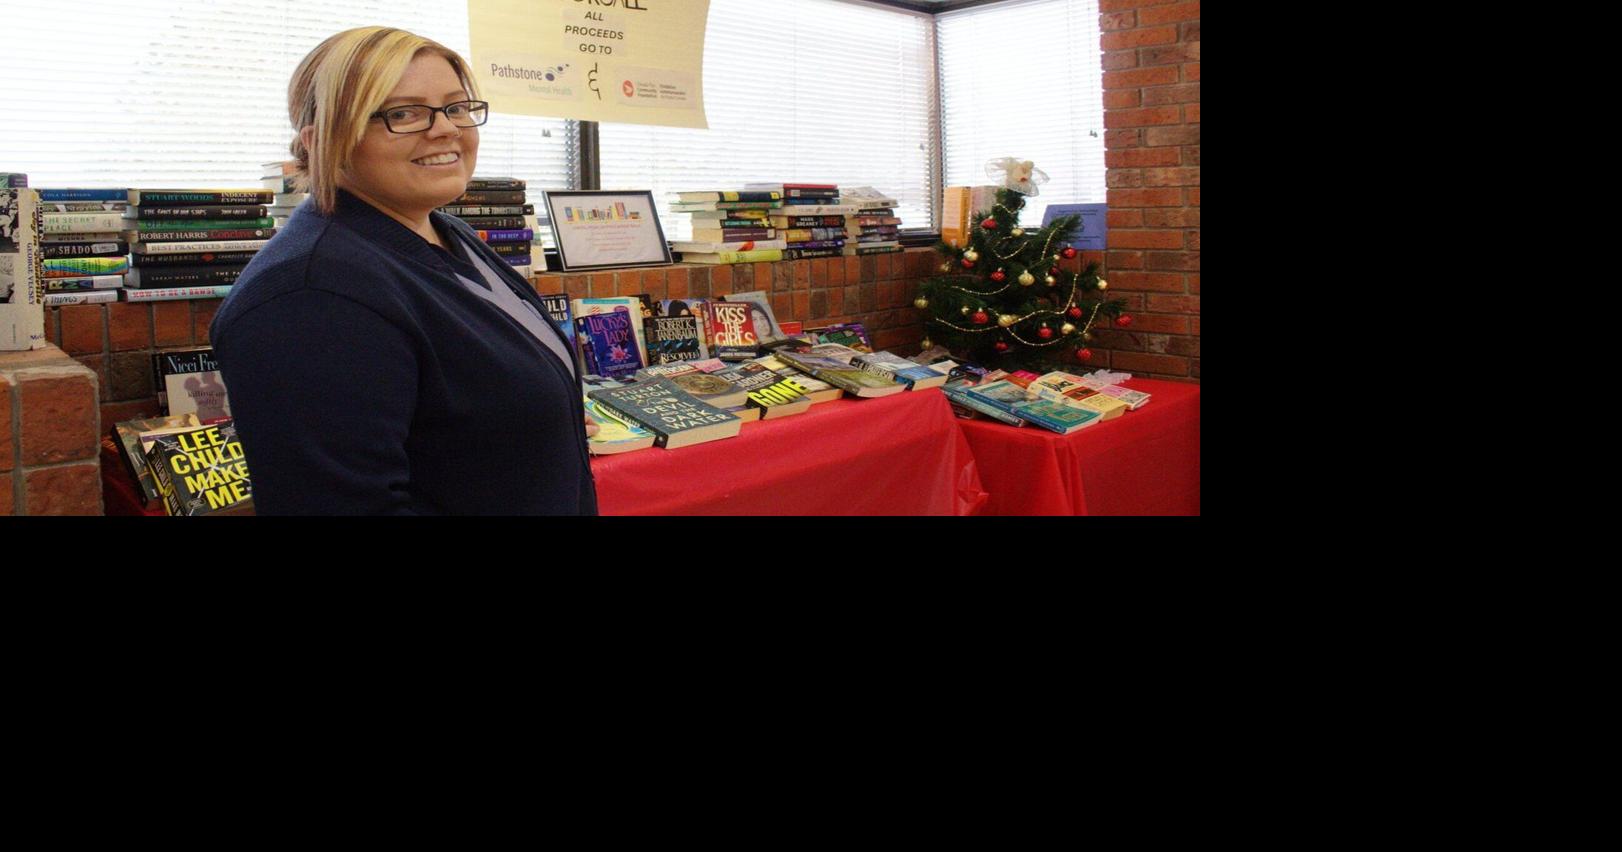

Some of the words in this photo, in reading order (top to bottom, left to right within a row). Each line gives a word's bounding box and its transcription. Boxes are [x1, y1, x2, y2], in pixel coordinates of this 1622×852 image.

[584, 11, 604, 21] ALL
[564, 25, 624, 40] PROCEEDS
[579, 43, 596, 53] GO
[599, 45, 612, 55] TO
[491, 63, 542, 81] Pathstone
[63, 216, 96, 224] SECRET
[140, 232, 174, 240] ROBERT
[176, 231, 208, 239] HARRIS
[715, 307, 747, 324] KISS
[656, 319, 684, 330] ROBERT
[722, 319, 744, 334] THE
[604, 329, 629, 346] LADY
[714, 332, 754, 346] GIRLS
[167, 354, 197, 373] Nicci
[611, 383, 663, 398] STUART
[619, 388, 672, 402] TURTON
[747, 377, 811, 408] GONE
[642, 401, 696, 414] DEVIL
[661, 408, 713, 423] DARK
[665, 413, 732, 430] WATER
[178, 427, 225, 452] LEE
[170, 442, 245, 475] CHILD
[185, 461, 250, 494] MAKE
[205, 480, 251, 510] ME
